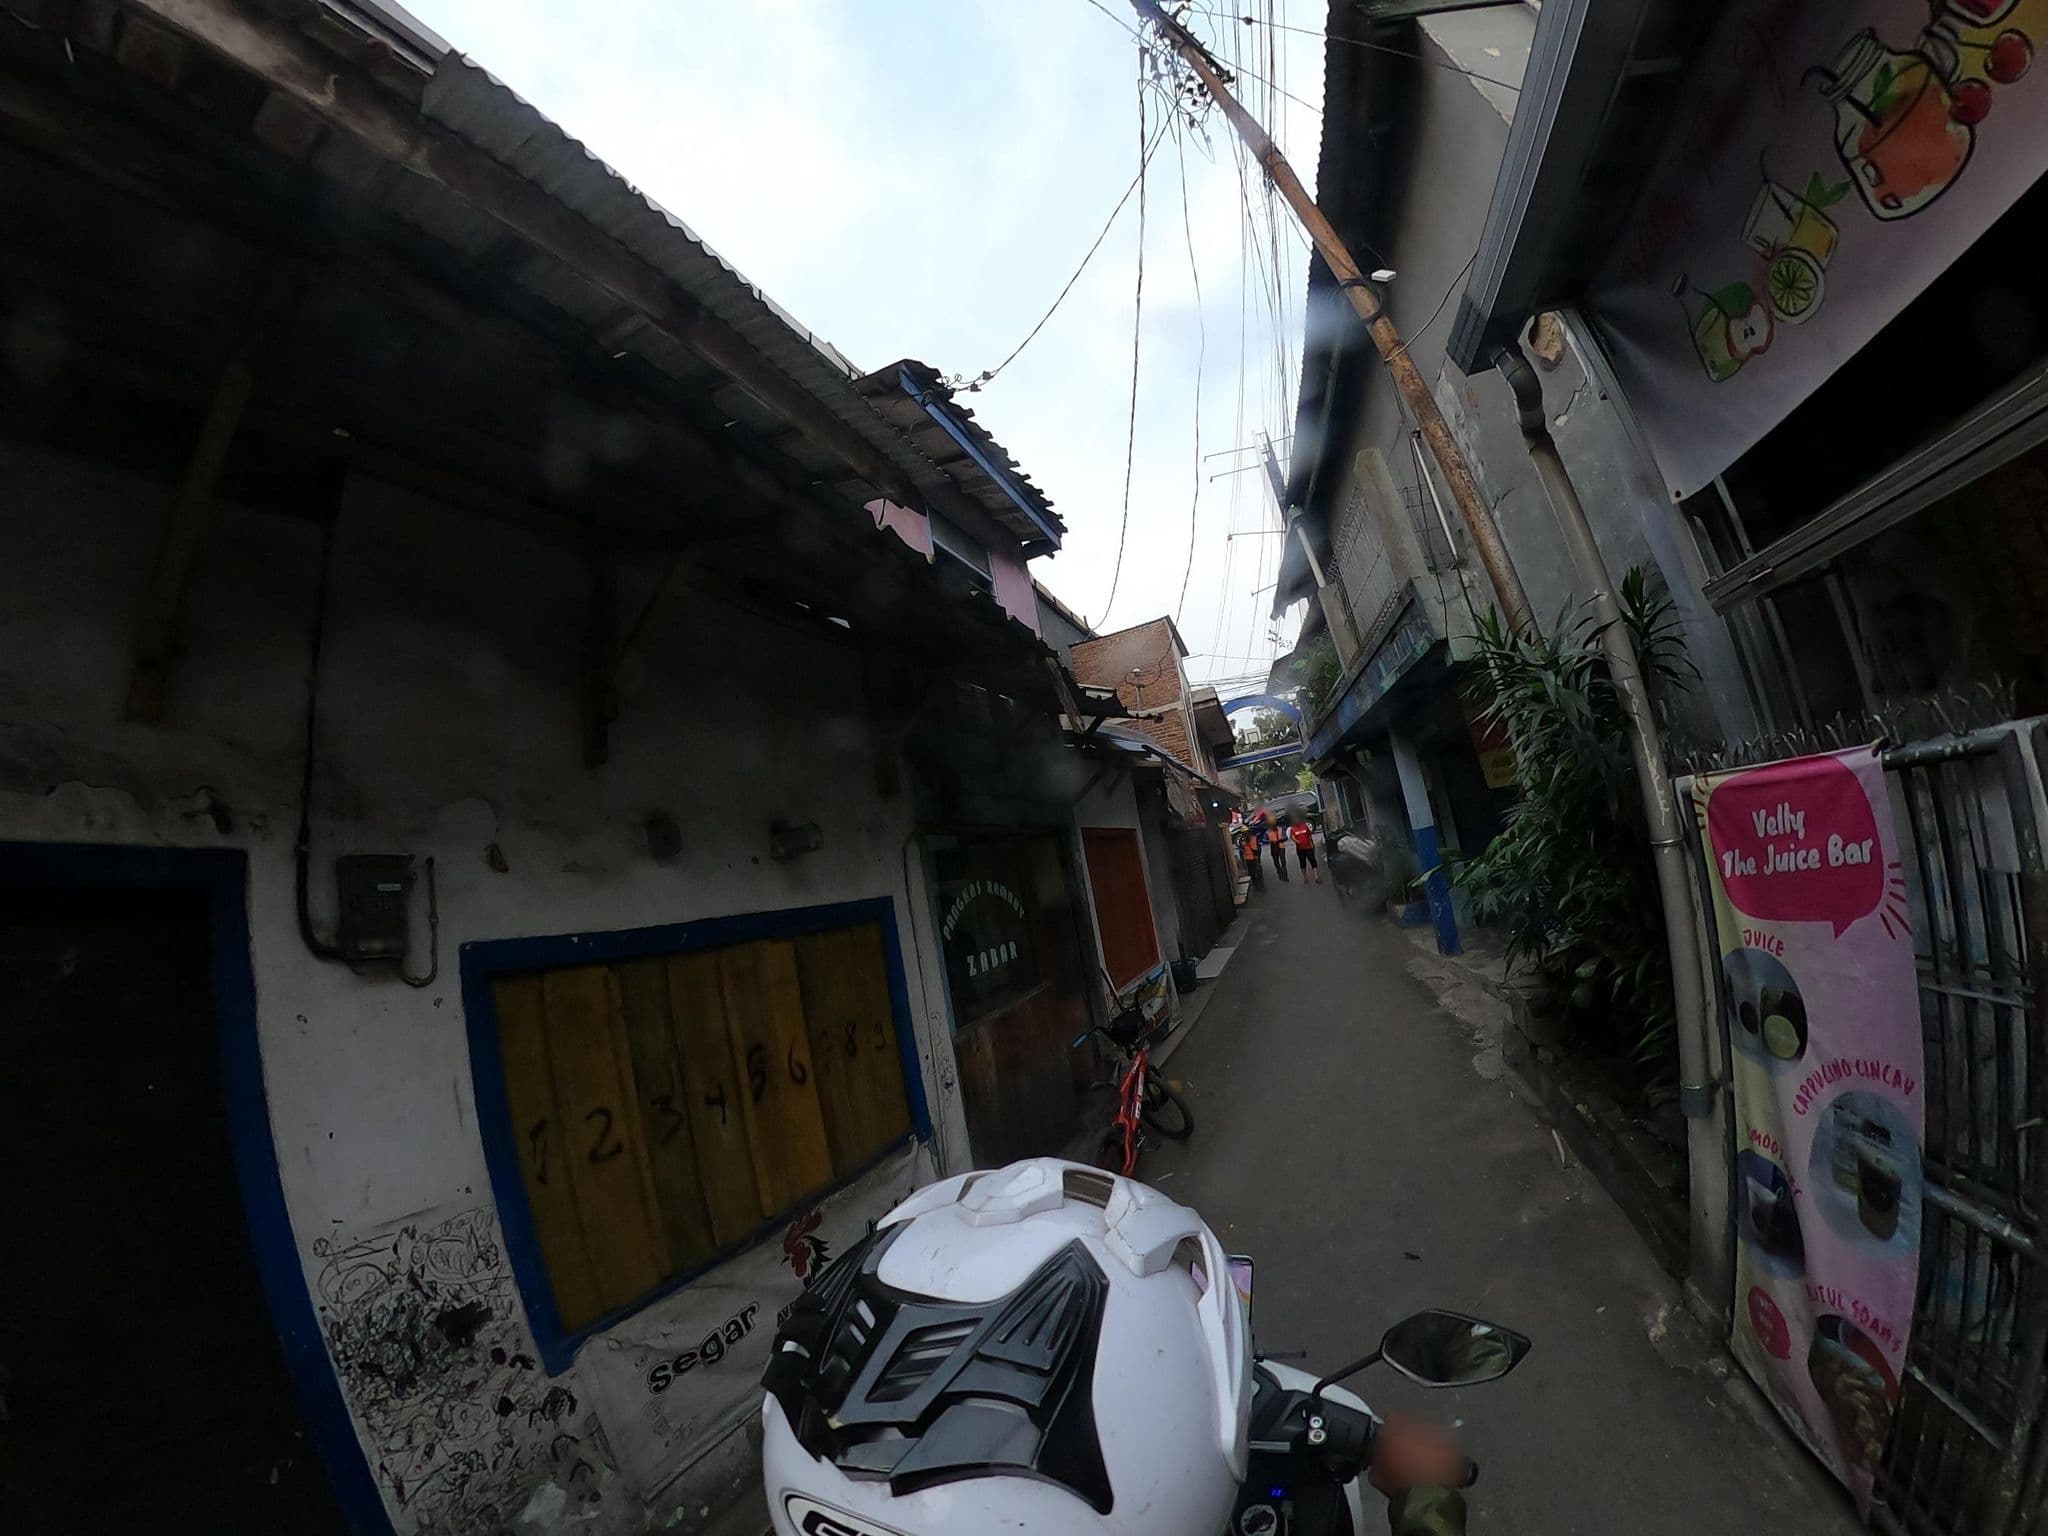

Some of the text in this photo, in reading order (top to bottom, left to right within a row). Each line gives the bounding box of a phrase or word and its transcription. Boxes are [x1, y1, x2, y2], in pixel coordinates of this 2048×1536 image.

[1752, 802, 1805, 840] Velly
[1722, 833, 1874, 879] The Juice Bar
[966, 940, 1018, 977] ZABAR
[1743, 929, 1784, 957] JUICE
[585, 1106, 623, 1164] 2
[651, 1095, 684, 1145] 3
[704, 1080, 727, 1125] 4
[787, 1038, 807, 1085] 6
[844, 1022, 857, 1058] 8
[648, 1302, 760, 1394] segar
